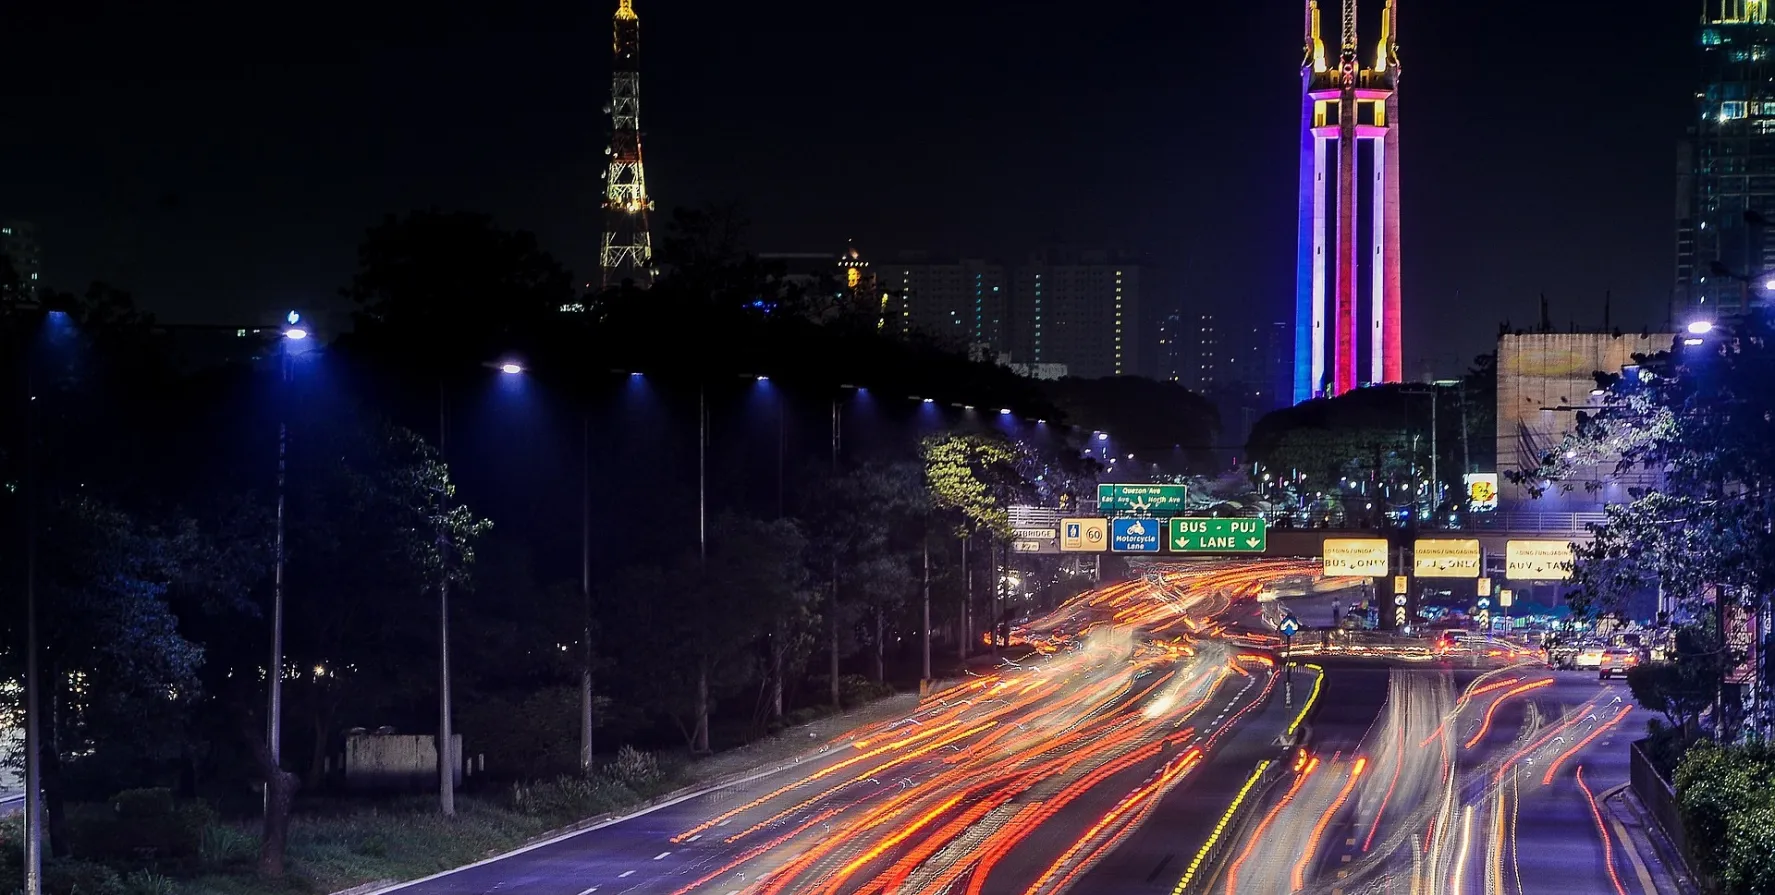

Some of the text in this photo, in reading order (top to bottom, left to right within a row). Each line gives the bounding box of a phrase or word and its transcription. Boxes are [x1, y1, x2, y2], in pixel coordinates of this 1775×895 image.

[1122, 487, 1161, 495] Quezon Ave
[1101, 495, 1130, 503] Eas Ave
[1148, 495, 1167, 504] North
[1180, 521, 1207, 533] BUS
[1230, 521, 1256, 533] PUJ
[1088, 530, 1100, 540] 60
[1116, 535, 1156, 544] Motorcycle
[1200, 536, 1236, 548] LANE
[1325, 559, 1346, 567] BUS
[1416, 560, 1437, 568] PJ
[1509, 561, 1533, 569] AUV
